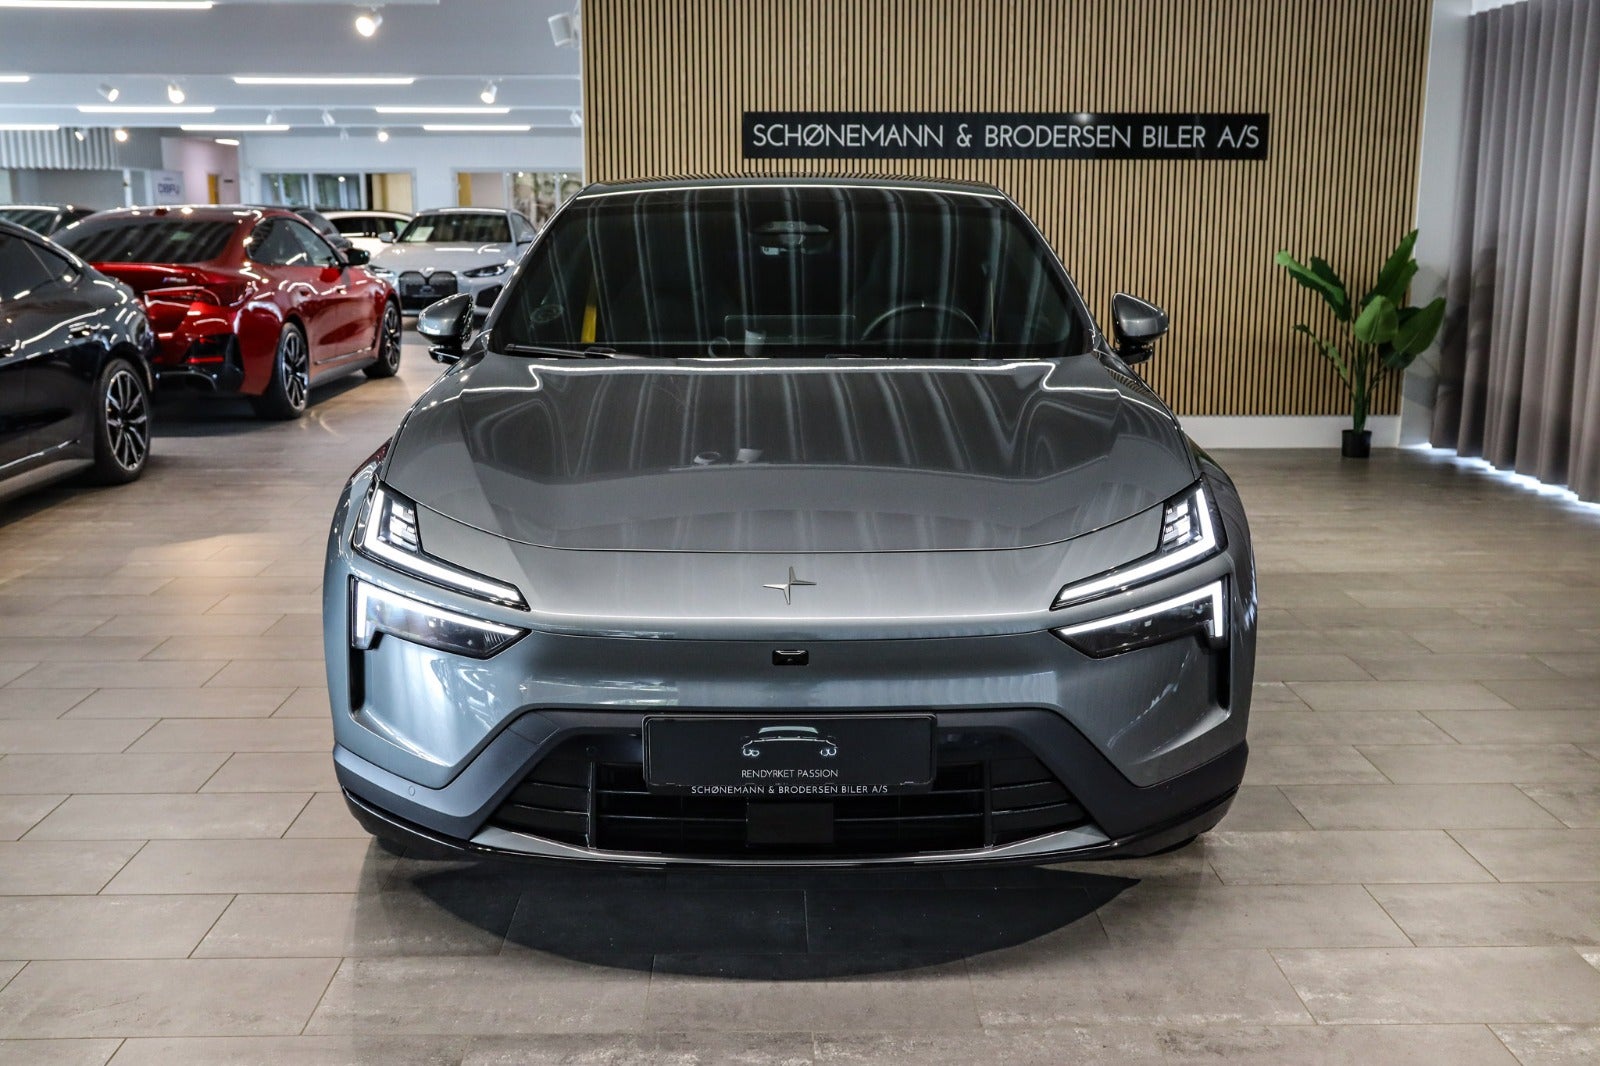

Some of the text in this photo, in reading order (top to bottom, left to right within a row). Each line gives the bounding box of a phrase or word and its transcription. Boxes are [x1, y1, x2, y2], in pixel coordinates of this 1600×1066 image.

[753, 124, 1259, 148] SCHØNEMANN & BRODERSEN BILER A/S
[741, 769, 839, 778] RENDYRKET PASSION
[691, 784, 888, 794] SCHØNEMANN & BRODERSEN BILER A/S
